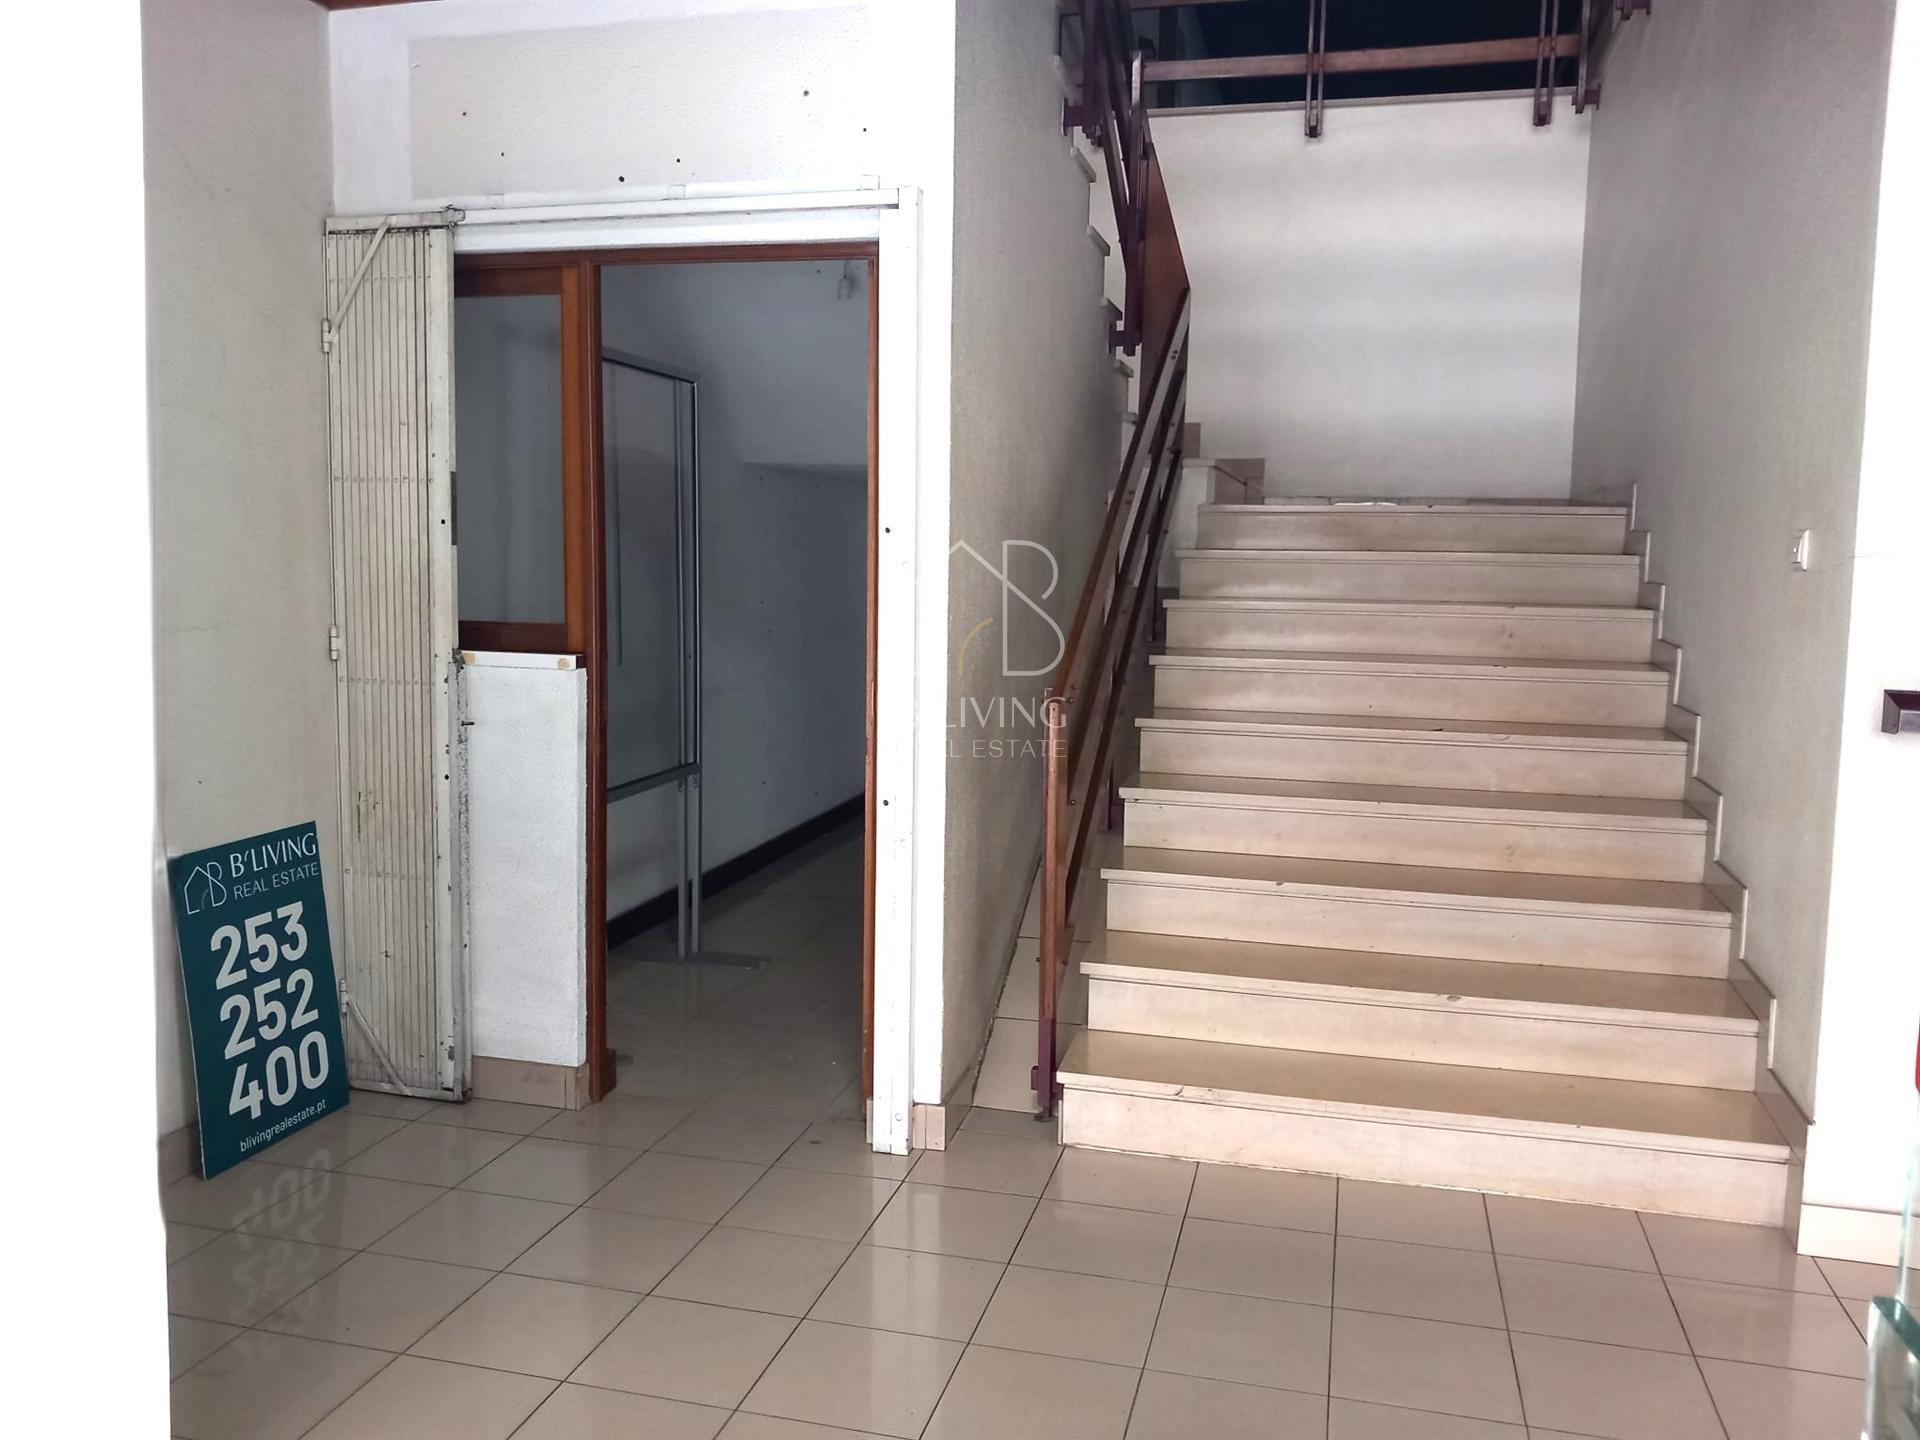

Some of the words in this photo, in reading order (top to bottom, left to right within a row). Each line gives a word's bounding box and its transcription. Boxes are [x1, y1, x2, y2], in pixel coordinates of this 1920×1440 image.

[233, 877, 270, 900] REAL
[271, 861, 320, 888] ESTATE
[210, 900, 308, 990] 253
[219, 967, 319, 1060] 252
[229, 1030, 330, 1120] 400
[239, 1098, 327, 1153] blivingrealestate.pt
